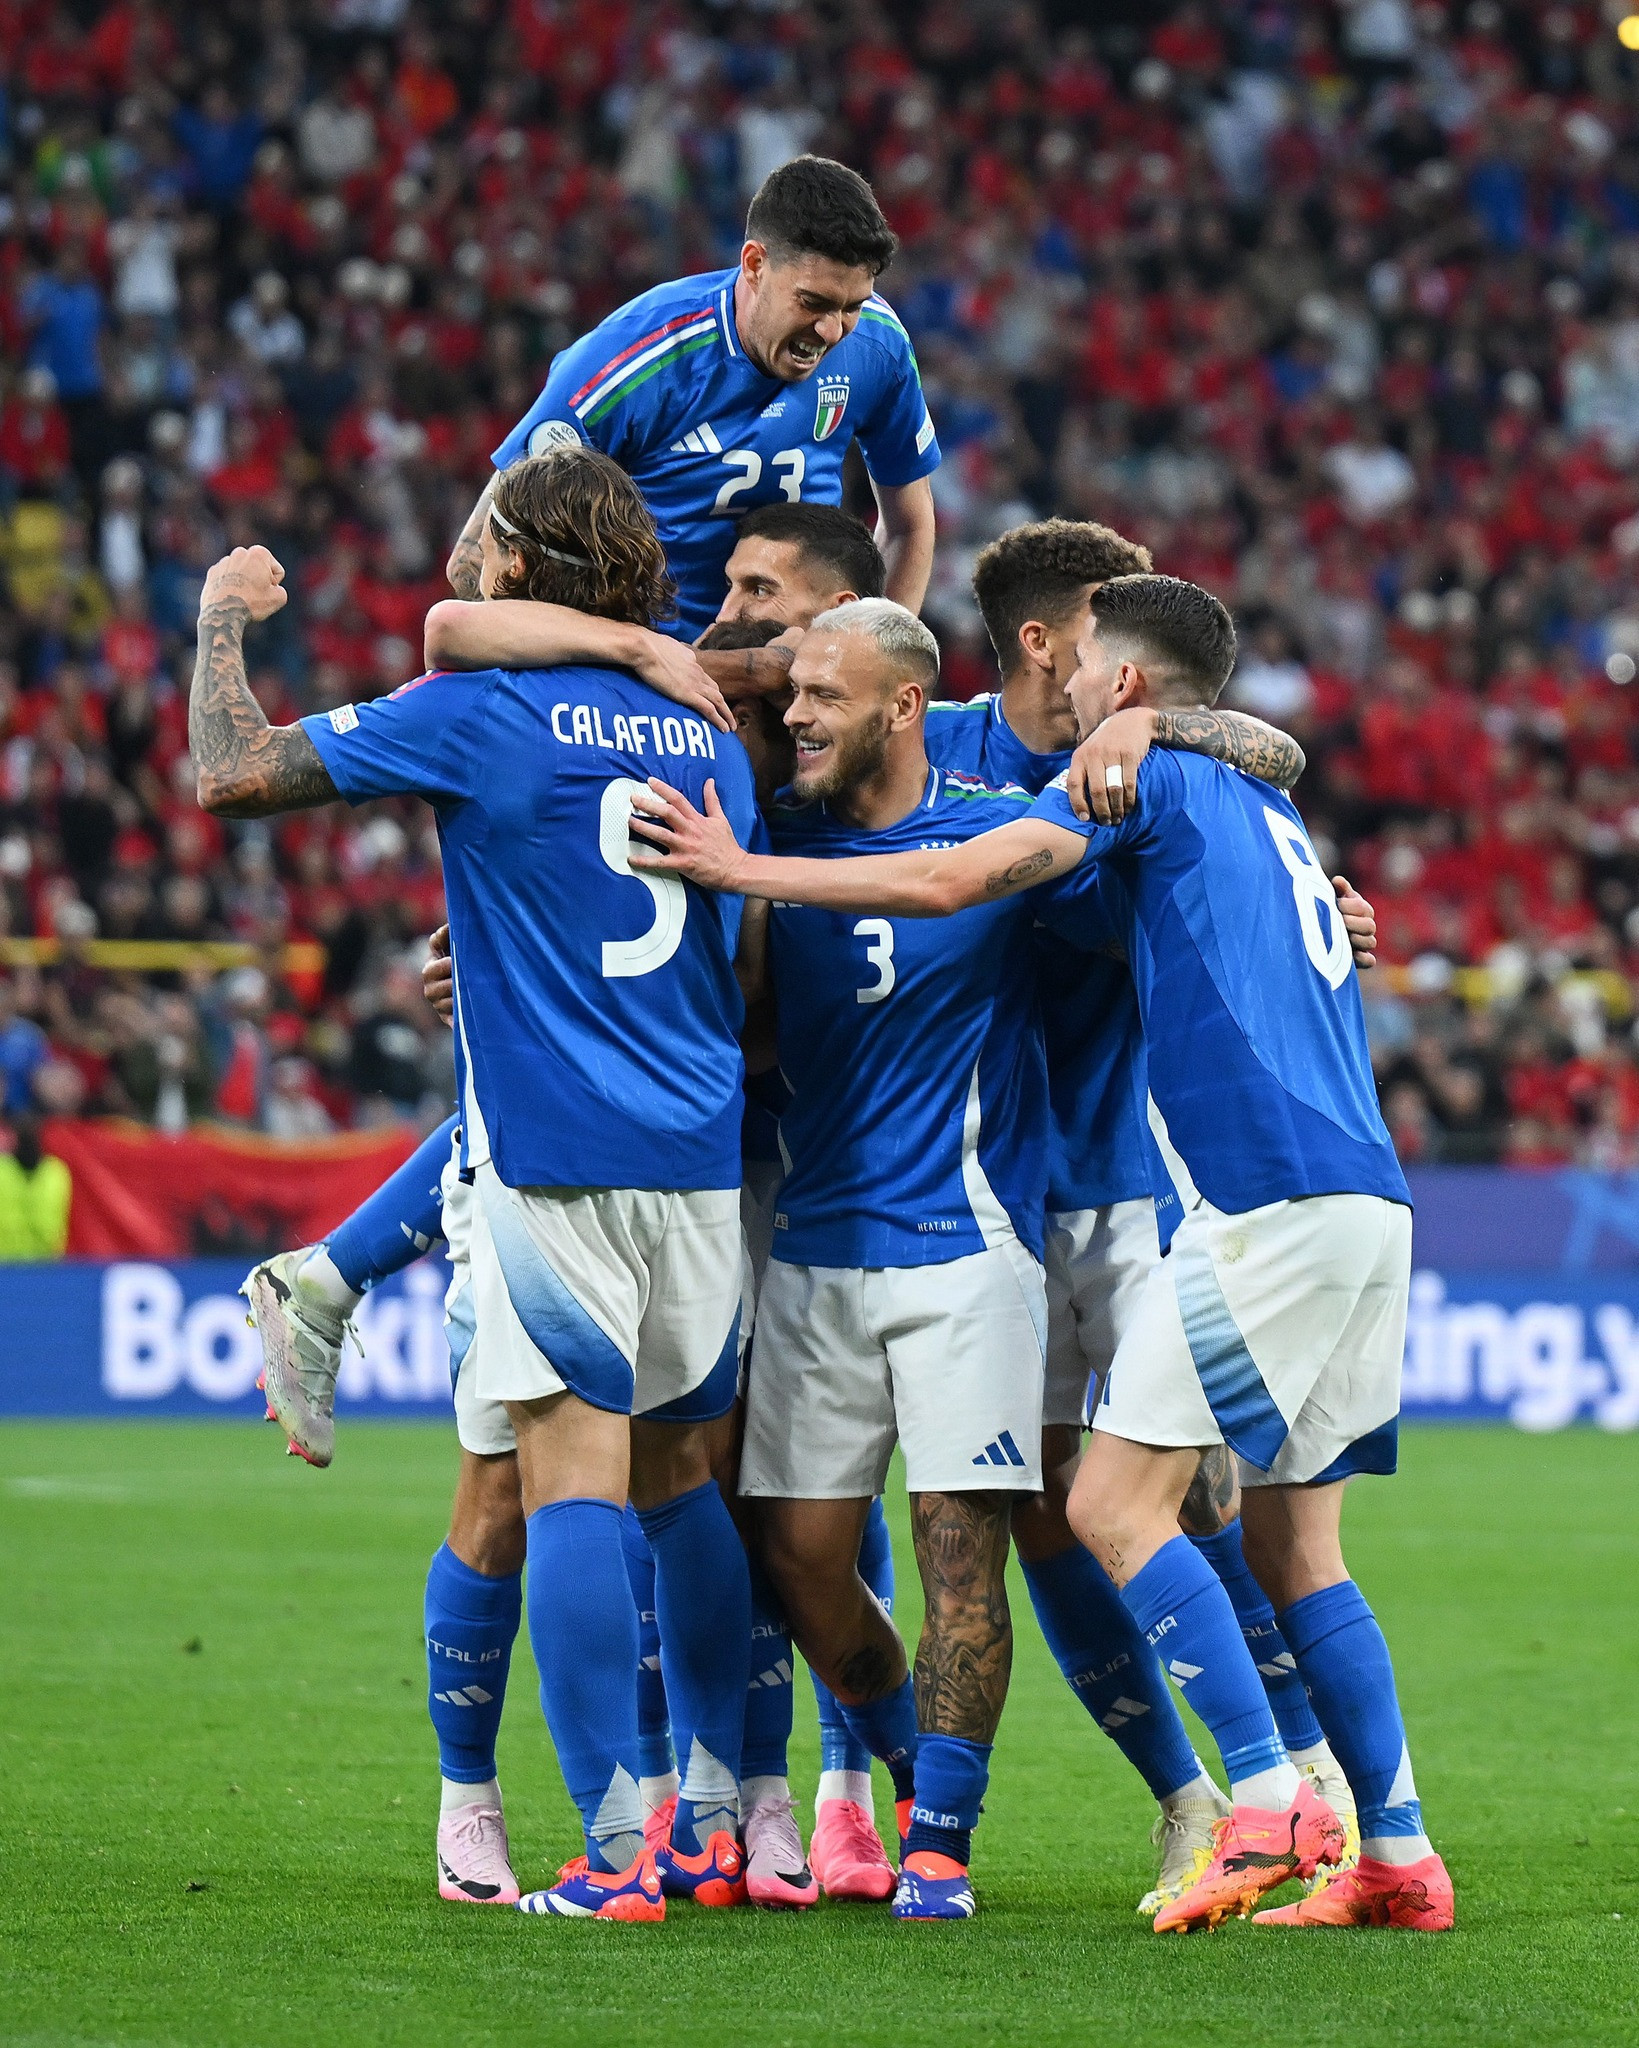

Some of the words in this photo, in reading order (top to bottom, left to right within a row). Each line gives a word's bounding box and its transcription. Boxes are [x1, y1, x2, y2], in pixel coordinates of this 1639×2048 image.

[820, 390, 846, 404] ITALIA
[709, 448, 805, 516] 23
[551, 702, 716, 760] CALAFIORI
[599, 777, 688, 978] 5
[1263, 805, 1354, 991] 8
[853, 918, 896, 1003] 3
[104, 1262, 450, 1399] Boki
